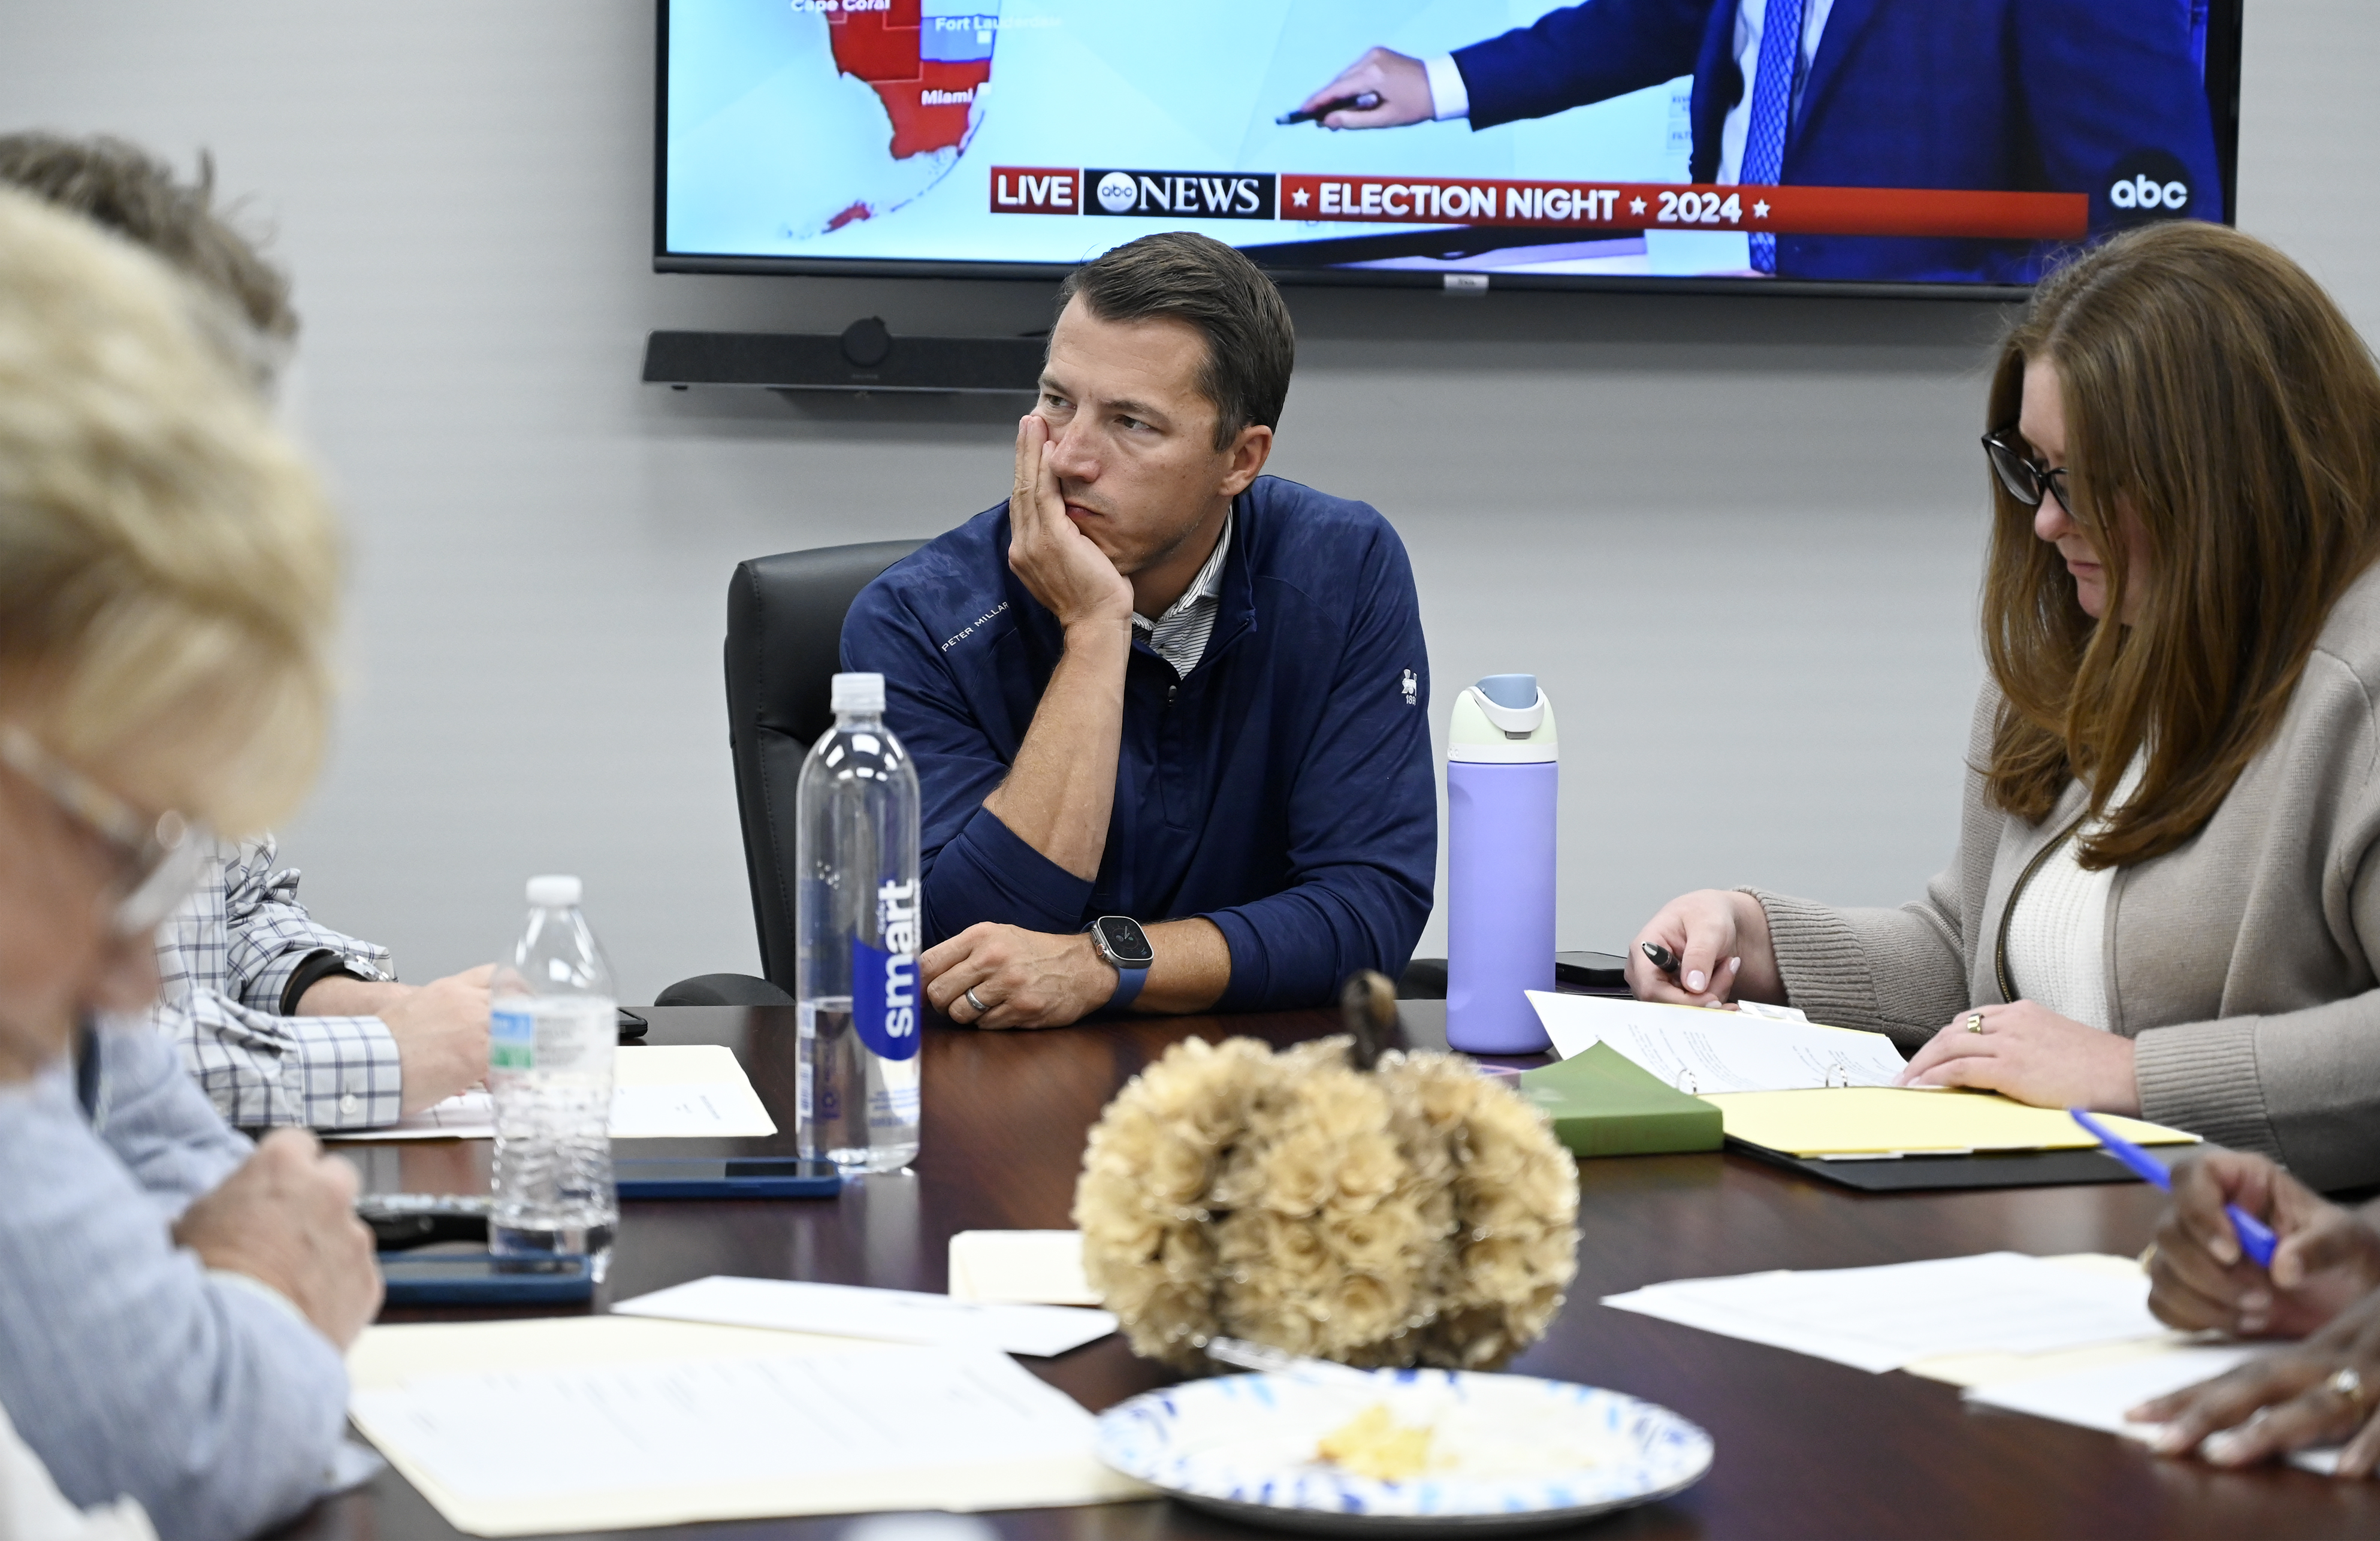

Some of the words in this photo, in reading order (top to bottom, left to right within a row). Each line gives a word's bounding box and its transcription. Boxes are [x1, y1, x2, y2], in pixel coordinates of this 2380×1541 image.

[791, 0, 838, 12] Cape
[842, 0, 890, 10] Coral
[935, 17, 969, 31] Fort
[922, 88, 973, 105] Miami
[998, 174, 1073, 206] LIVE
[1101, 186, 1132, 197] abc
[1138, 176, 1260, 213] NEWS
[1319, 182, 1496, 218] ELECTION
[1506, 188, 1620, 222] NIGHT
[1657, 192, 1742, 223] 2024
[2111, 174, 2187, 209] abc
[941, 627, 974, 652] PETER
[974, 602, 1009, 627] MILLAR
[878, 879, 914, 1038] smart
